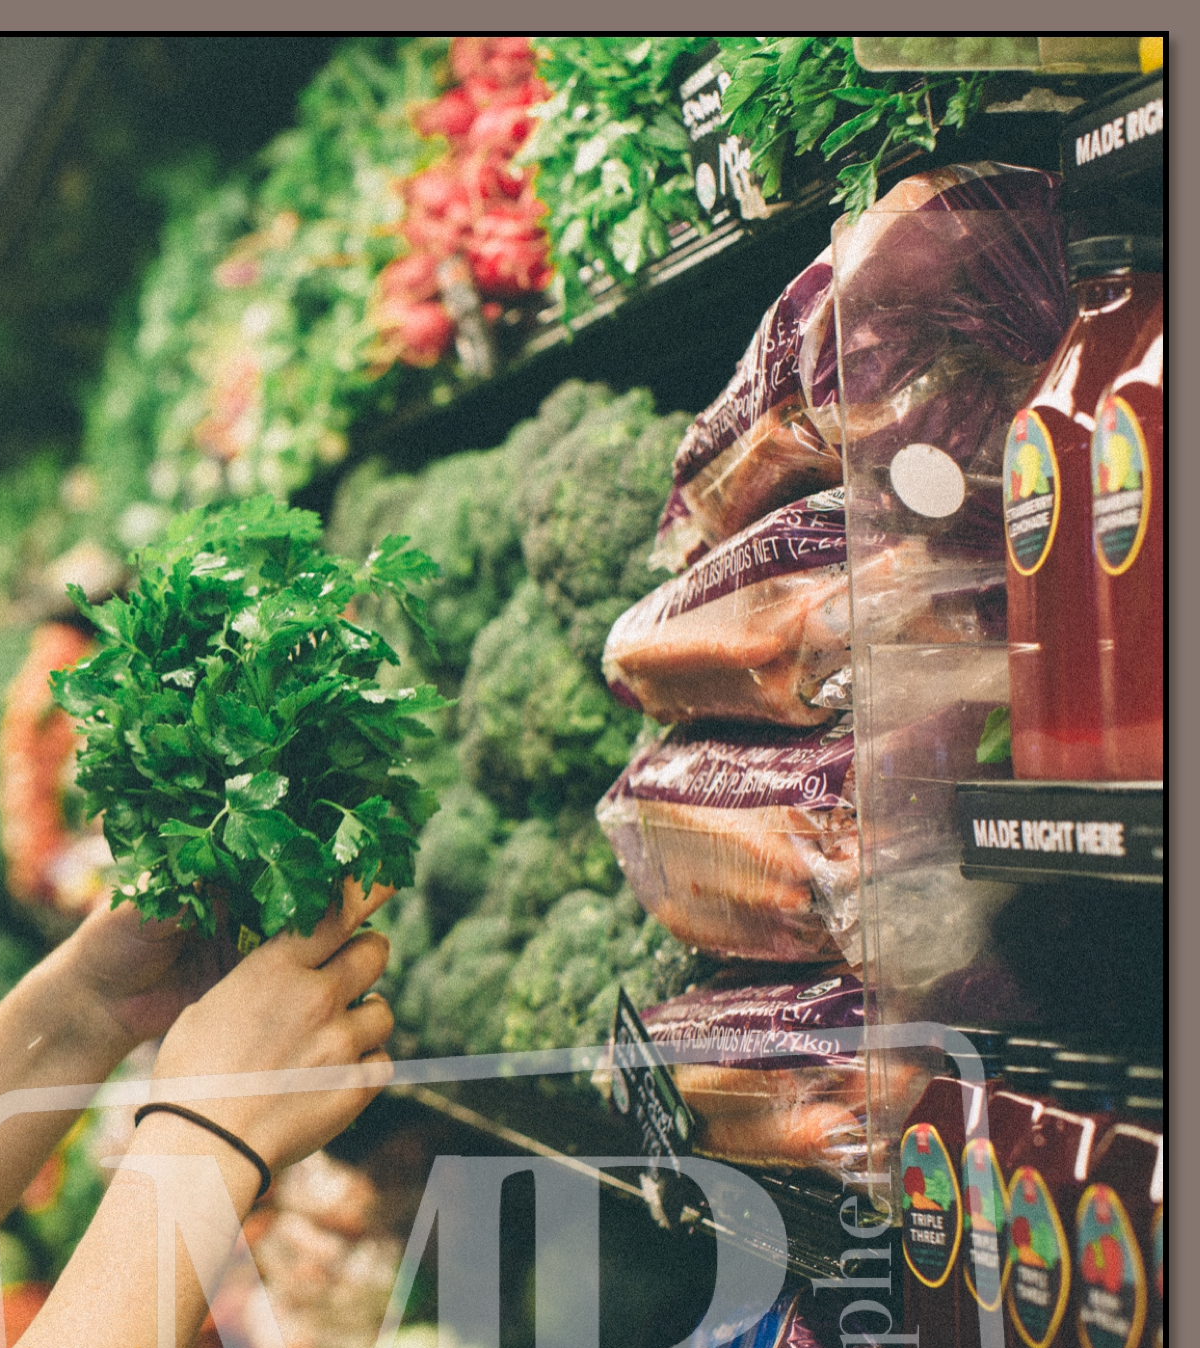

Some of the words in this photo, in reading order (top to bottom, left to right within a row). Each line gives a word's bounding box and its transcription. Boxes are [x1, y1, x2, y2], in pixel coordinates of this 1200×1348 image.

[1075, 116, 1125, 166] MADE
[753, 535, 780, 567] NET
[973, 819, 1021, 849] MADE
[1021, 820, 1074, 853] RIGHT
[1075, 821, 1127, 857] HERE
[909, 1228, 947, 1246] THREAT
[910, 1212, 944, 1230] TRIPLE
